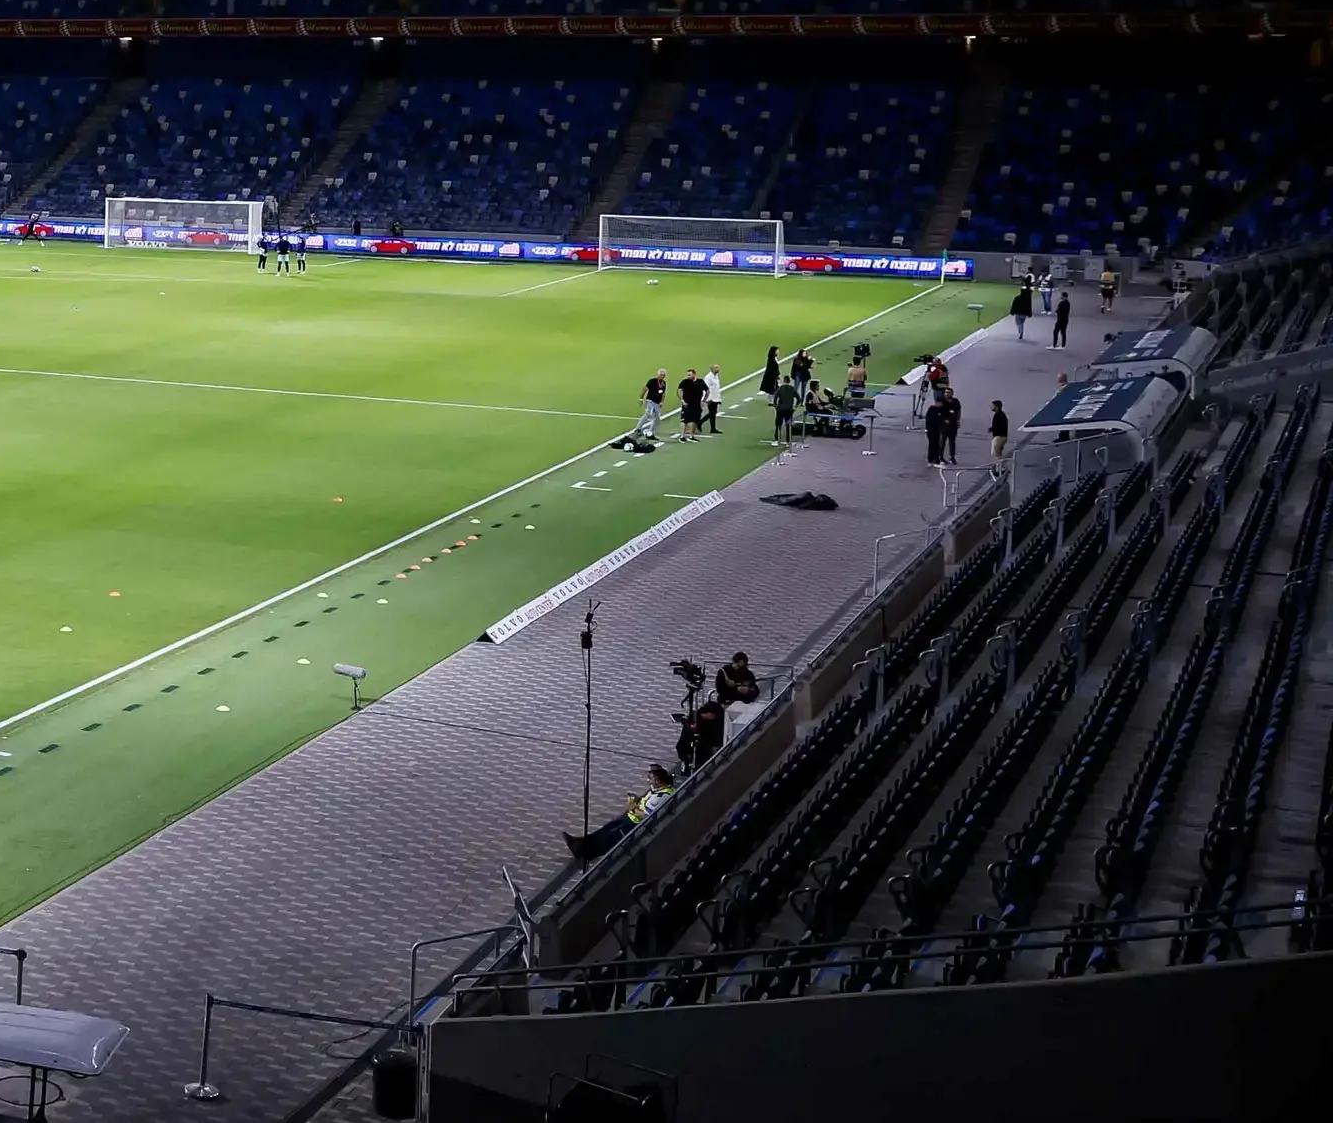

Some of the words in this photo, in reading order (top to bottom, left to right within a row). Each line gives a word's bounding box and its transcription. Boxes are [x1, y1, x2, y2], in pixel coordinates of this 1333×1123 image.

[841, 258, 872, 269] מפחד
[873, 259, 888, 270] לא
[890, 260, 919, 271] הנצח
[920, 261, 936, 272] עם
[553, 577, 584, 600] VOLVO
[490, 615, 525, 639] VOLVO
